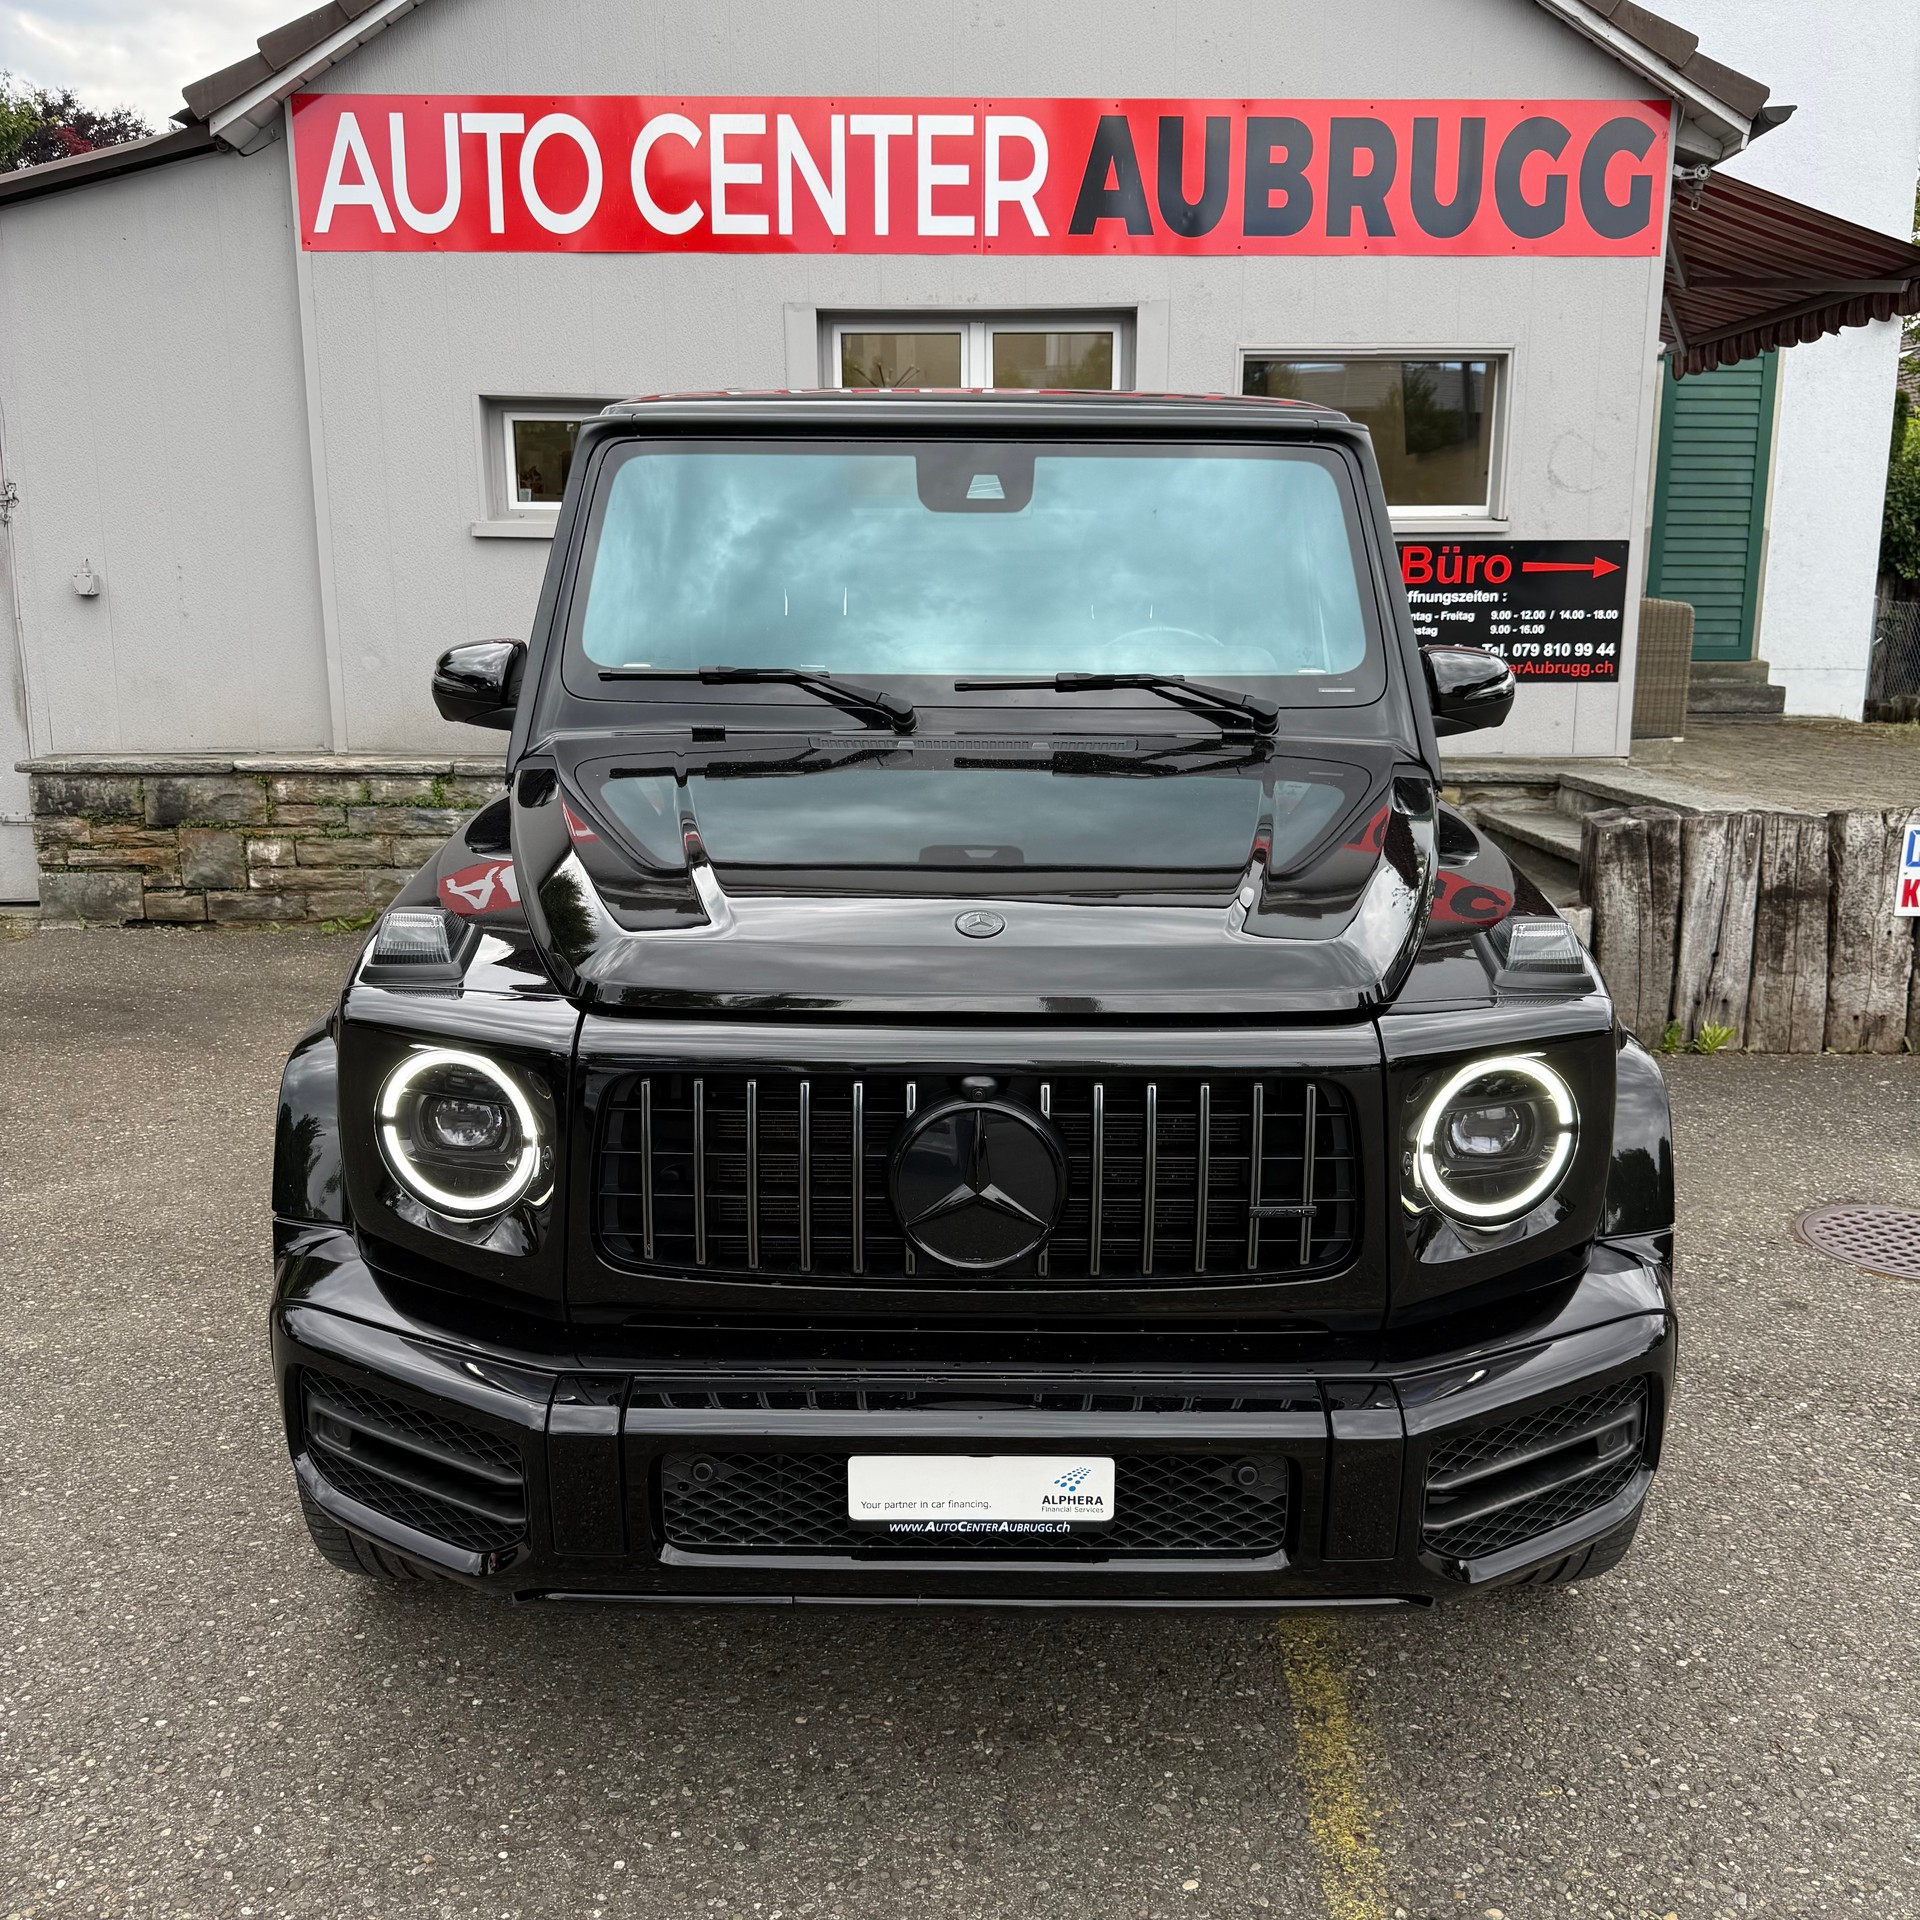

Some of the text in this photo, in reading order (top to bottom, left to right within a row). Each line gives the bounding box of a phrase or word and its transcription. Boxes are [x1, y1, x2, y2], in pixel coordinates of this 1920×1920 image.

[314, 111, 1657, 239] AUTO CENTER AUBRUGG
[1401, 545, 1513, 584] Büro
[1407, 590, 1499, 605] ffnungszeiten
[1411, 611, 1432, 623] ntag
[1440, 611, 1475, 623] Freitag
[1490, 610, 1512, 621] 9.00
[1520, 610, 1546, 621] 12.00
[1559, 609, 1585, 620] 14.00
[1593, 609, 1619, 620] 18.00
[1414, 626, 1439, 637] stag
[1490, 624, 1511, 635] 9.00
[1519, 624, 1545, 635] 16.00
[1512, 643, 1540, 658] 079
[1543, 643, 1571, 657] 810
[1574, 643, 1593, 657] 99
[1596, 642, 1616, 657] 44
[1509, 660, 1614, 677] erAubrugg.ch
[861, 1500, 992, 1511] Your partner in car financing.
[1041, 1495, 1104, 1506] ALPHERA
[1041, 1506, 1104, 1514] Financial Services
